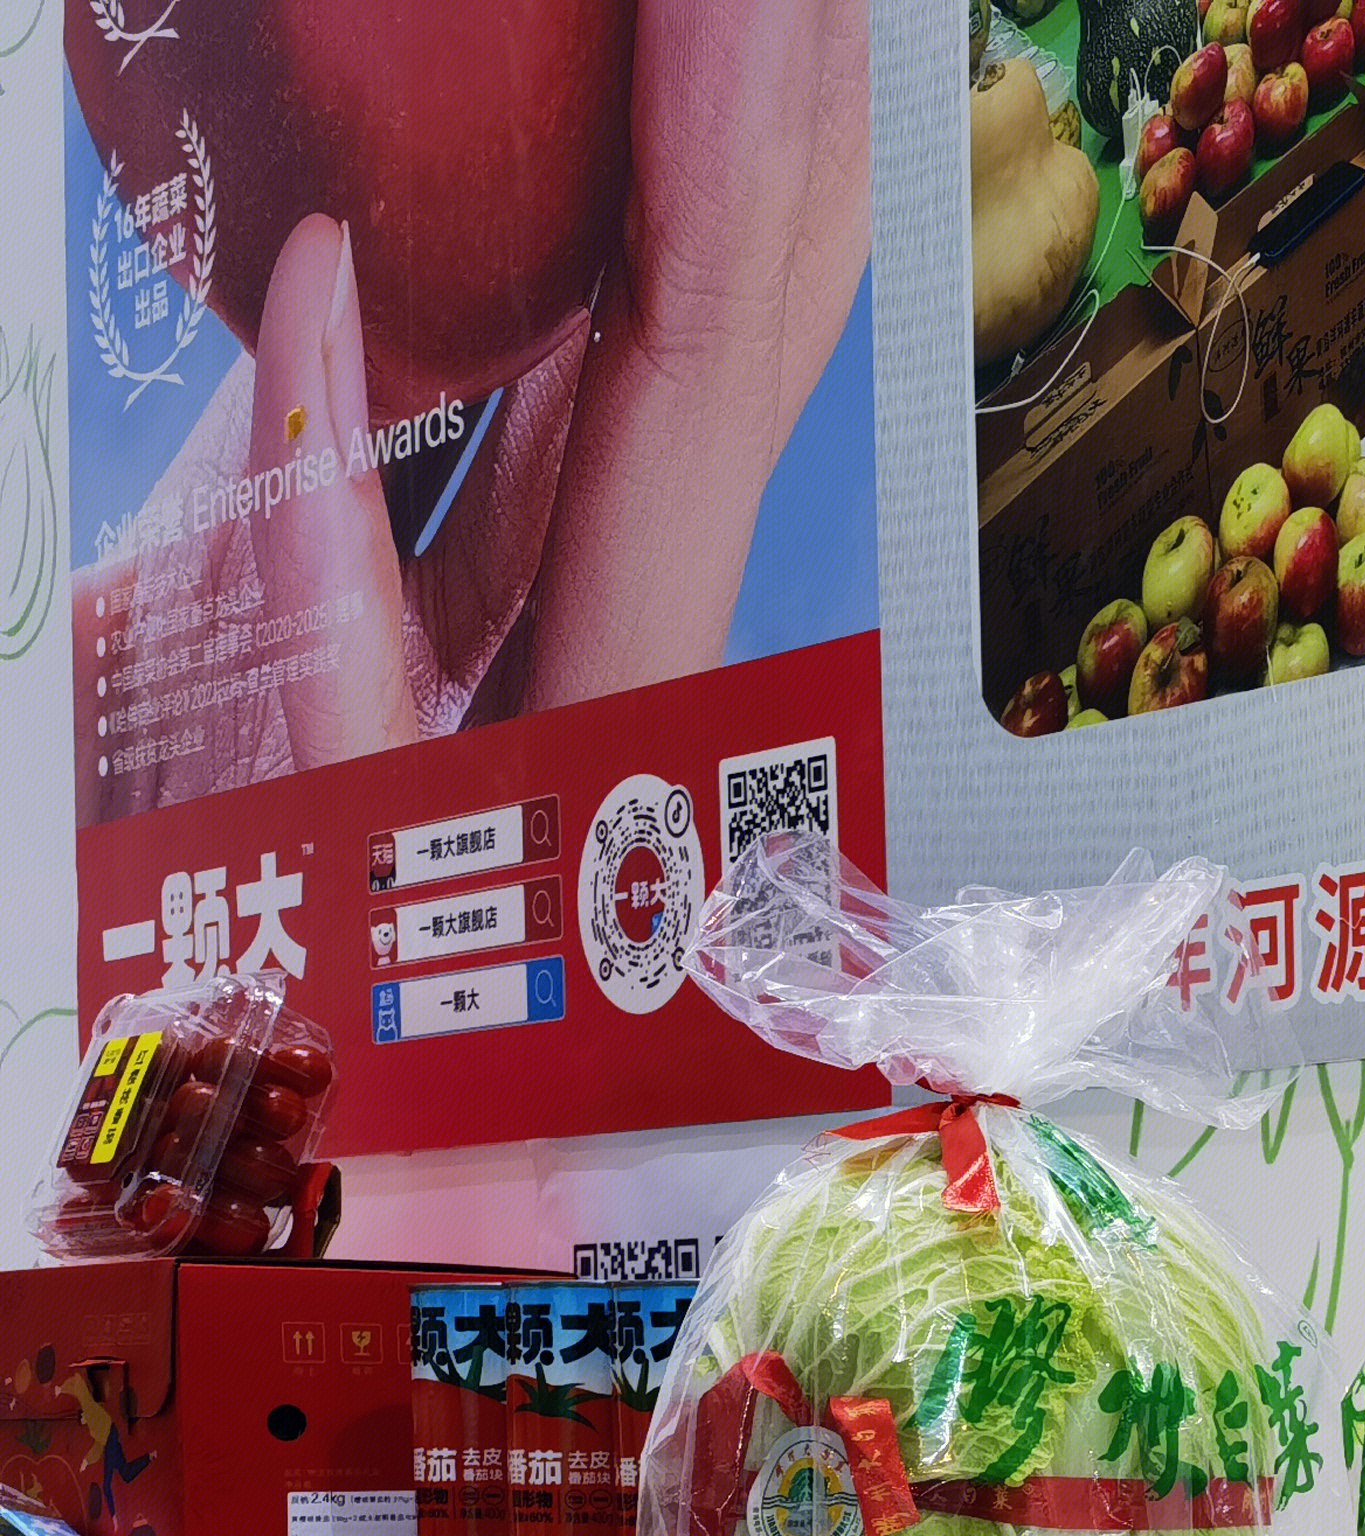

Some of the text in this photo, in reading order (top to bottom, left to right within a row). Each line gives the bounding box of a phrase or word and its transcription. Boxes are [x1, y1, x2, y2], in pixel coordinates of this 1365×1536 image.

[113, 172, 188, 243] 16年蔬菜
[116, 222, 188, 291] 出口企业
[134, 279, 169, 330] 出品
[191, 446, 338, 534] Enterprise
[345, 390, 467, 478] Awards
[416, 825, 497, 865] 一颗大旗舰店
[613, 876, 670, 911] 一颗大
[102, 850, 307, 985] 一颗大
[418, 905, 499, 941] 一颗大旗舰店
[440, 987, 480, 1015] 一颗大
[462, 1447, 503, 1467] 去皮
[567, 1450, 611, 1470] 去皮
[310, 1491, 347, 1508] 2.4kg
